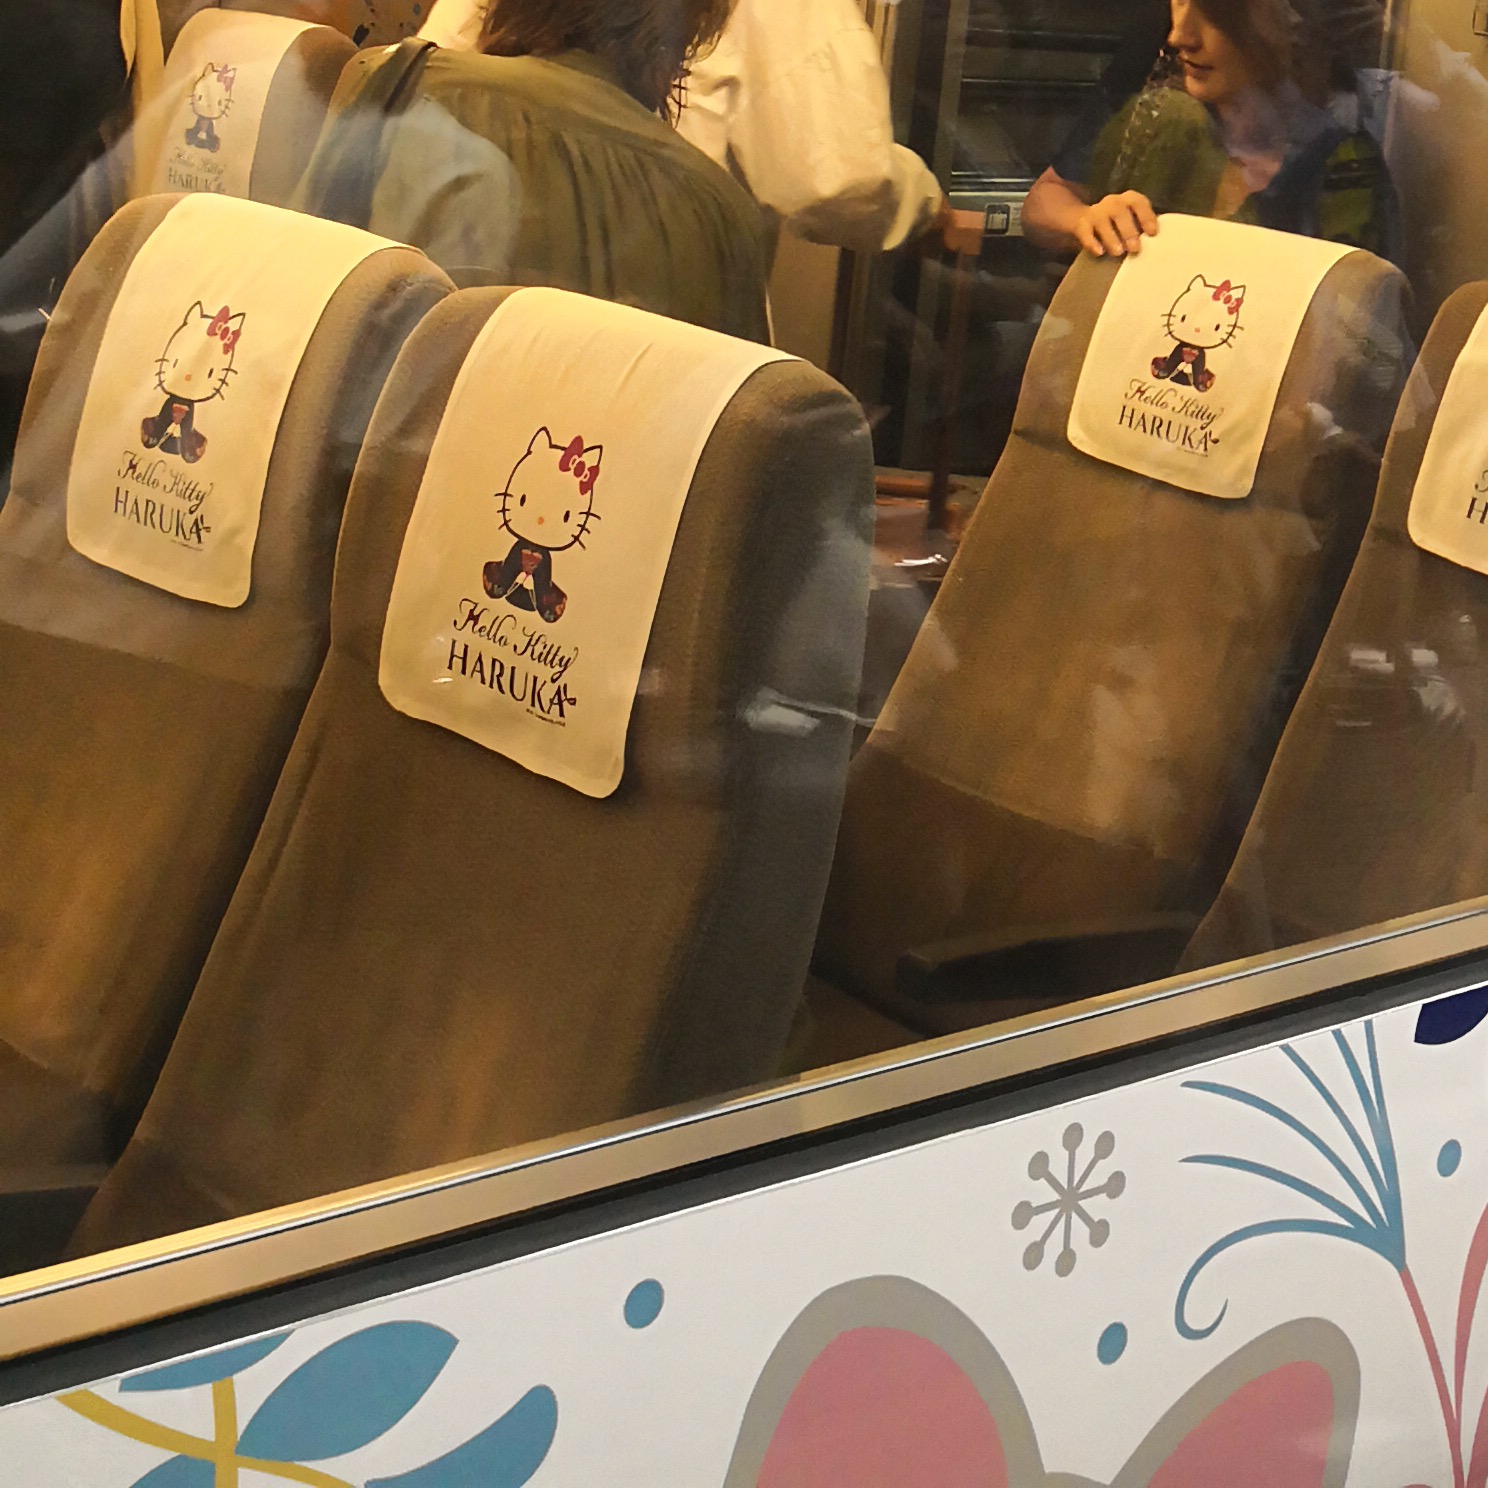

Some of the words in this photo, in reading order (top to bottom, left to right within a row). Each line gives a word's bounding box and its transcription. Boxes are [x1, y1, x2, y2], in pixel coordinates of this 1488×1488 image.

[1118, 404, 1209, 452] HARUKA
[1124, 378, 1178, 410] Hello
[1171, 394, 1225, 431] Kitty
[117, 450, 167, 489] Hello
[163, 468, 214, 515] Kitty
[114, 486, 204, 544] HARUKA
[453, 598, 517, 647] Hello
[513, 625, 579, 684] Kitty
[447, 638, 566, 718] HARUKA
